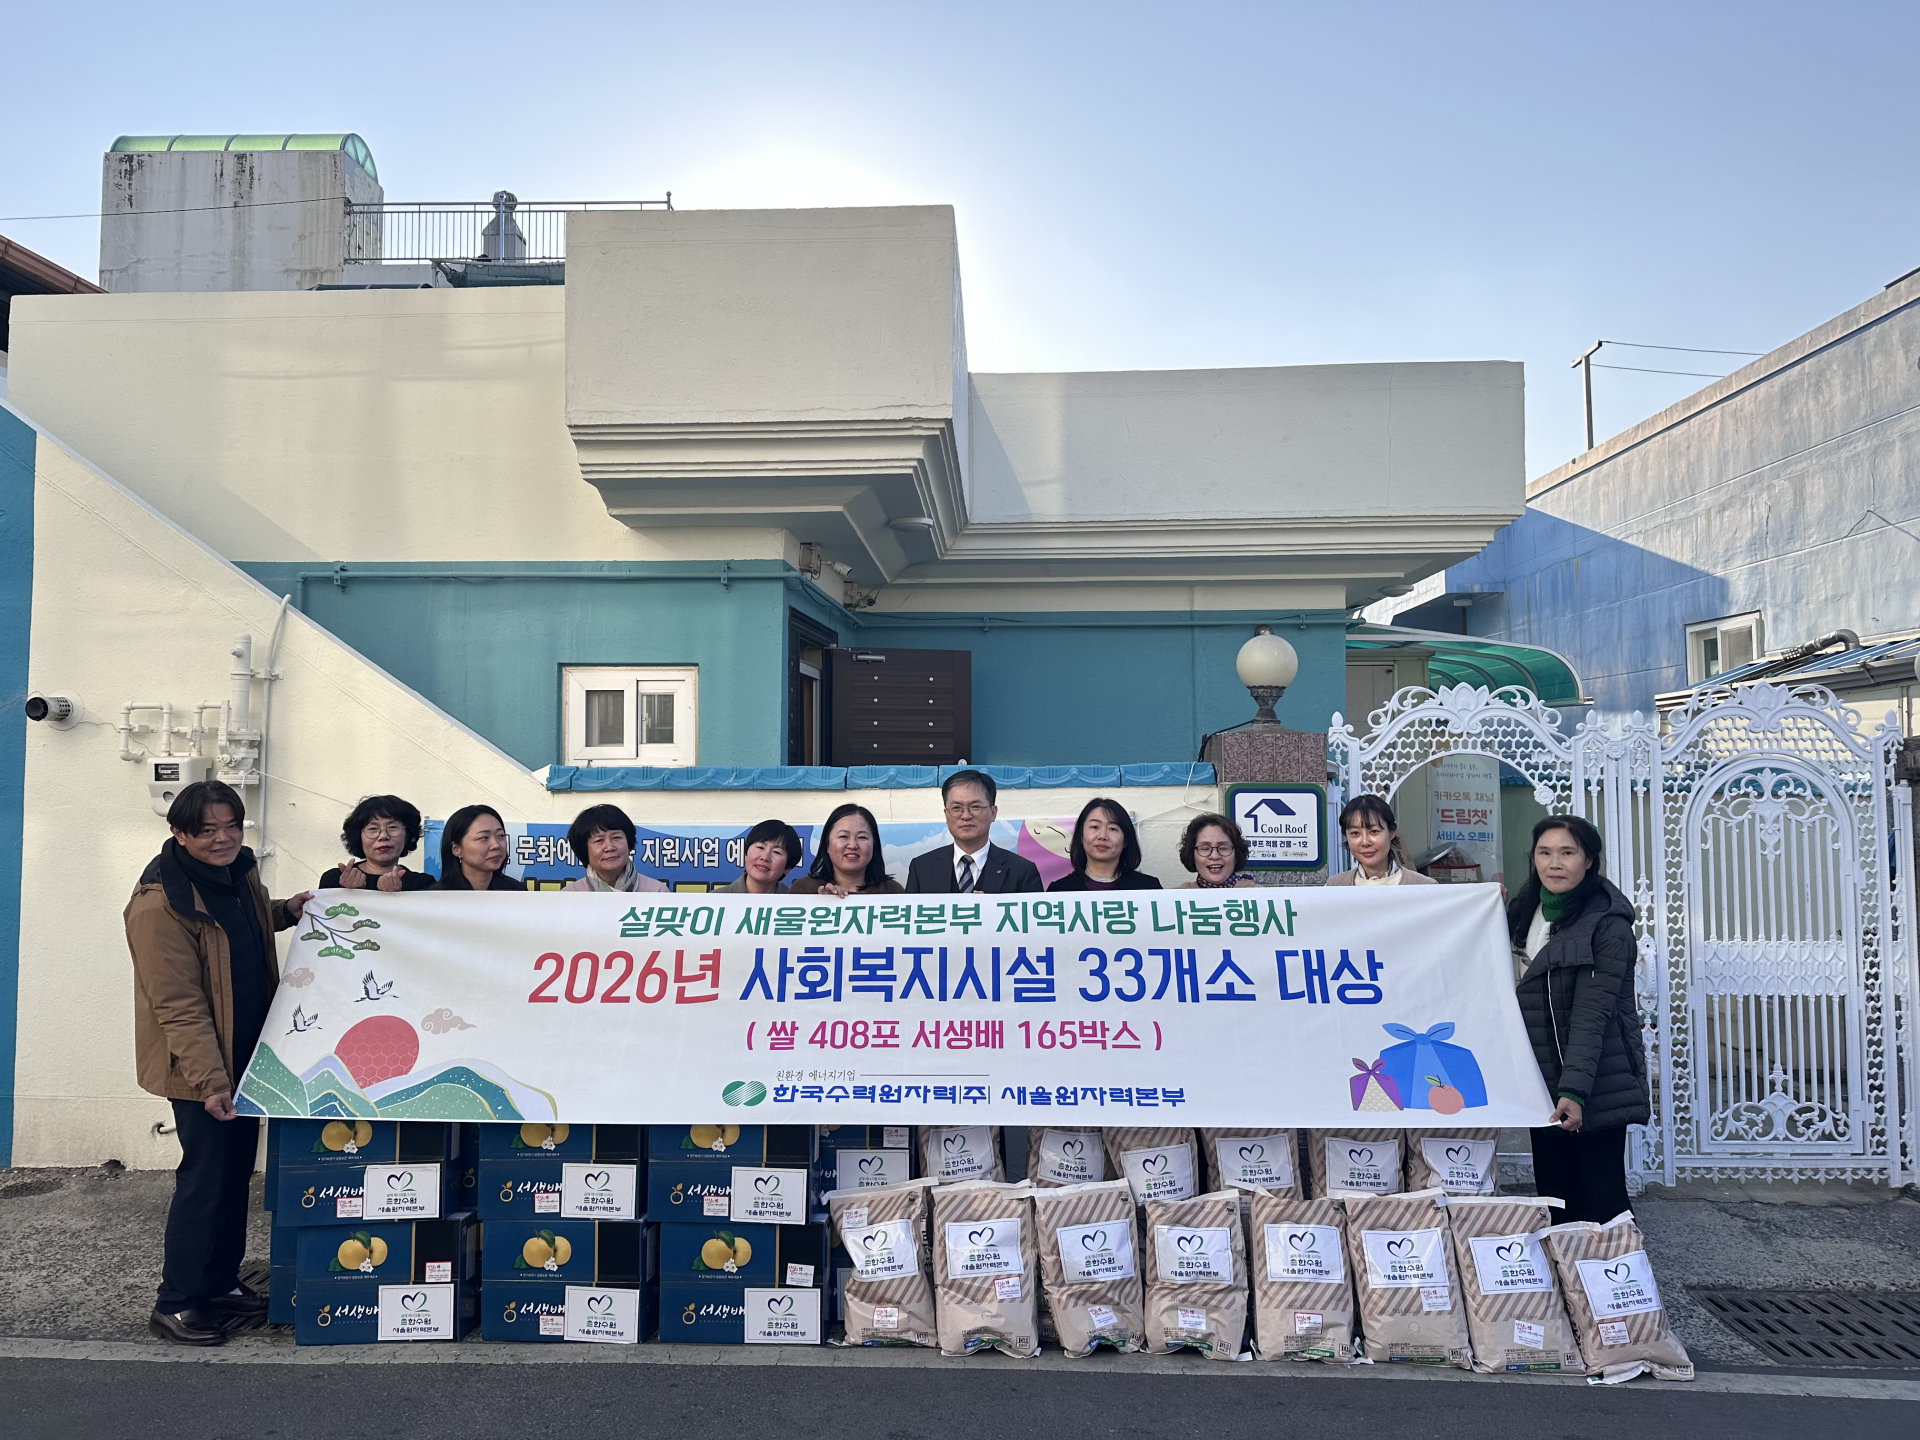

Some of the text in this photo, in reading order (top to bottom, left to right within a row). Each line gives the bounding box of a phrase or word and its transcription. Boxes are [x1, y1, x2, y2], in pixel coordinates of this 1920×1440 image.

[1434, 791, 1494, 802] 카카오톡 채널
[1260, 824, 1308, 834] Cool Roof
[1436, 831, 1494, 842] 서비스 오픈!!
[641, 837, 719, 868] 지원사업
[620, 899, 1298, 938] 설맞이 새울원자력본부 지역사랑 나눔행사
[528, 946, 1384, 1005] 2026년 사회복지시설 33개소 대상
[767, 1021, 799, 1051] 쌀
[808, 1020, 900, 1049] 408포
[911, 1020, 1004, 1050] 서생배
[1018, 1020, 1141, 1050] 165박스
[775, 1070, 856, 1081] 친환경 에너지기업
[1000, 1085, 1186, 1107] 새울원자력본부
[952, 1158, 974, 1166] 한수원
[939, 1164, 983, 1176] 새울원자력본부
[1065, 1164, 1086, 1172] 한수원
[1249, 1168, 1272, 1176] 한수원
[1050, 1169, 1093, 1180] 새울원자력본부
[1357, 1172, 1380, 1180] 한수원
[1456, 1171, 1478, 1179] 한수원
[517, 1181, 562, 1193] 서생배
[1153, 1180, 1175, 1189] 한수원
[319, 1186, 364, 1198] 서생배
[687, 1184, 732, 1196] 서생배
[1139, 1187, 1183, 1198] 새울원자력본부
[761, 1201, 783, 1209] 한수원
[871, 1257, 894, 1265] 한수원
[976, 1253, 1000, 1261] 한수원
[1092, 1258, 1115, 1266] 한수원
[962, 1261, 1009, 1270] 새울원자력본부
[1298, 1259, 1322, 1267] 한수원
[1399, 1264, 1423, 1272] 한수원
[1078, 1265, 1124, 1276] 새울원자력본부
[1283, 1268, 1330, 1276] 새울원자력본부
[1383, 1272, 1434, 1280] 새울원자력본부
[1495, 1277, 1543, 1286] 새울원자력본부
[1621, 1289, 1644, 1300] 한수원
[520, 1302, 565, 1315] 서생배
[1607, 1297, 1653, 1310] 새울원자력본부
[334, 1304, 379, 1318] 서생배
[700, 1304, 745, 1318] 서생배
[408, 1318, 431, 1326] 한수원
[594, 1320, 616, 1328] 한수원
[578, 1329, 624, 1337] 새울원자력본부
